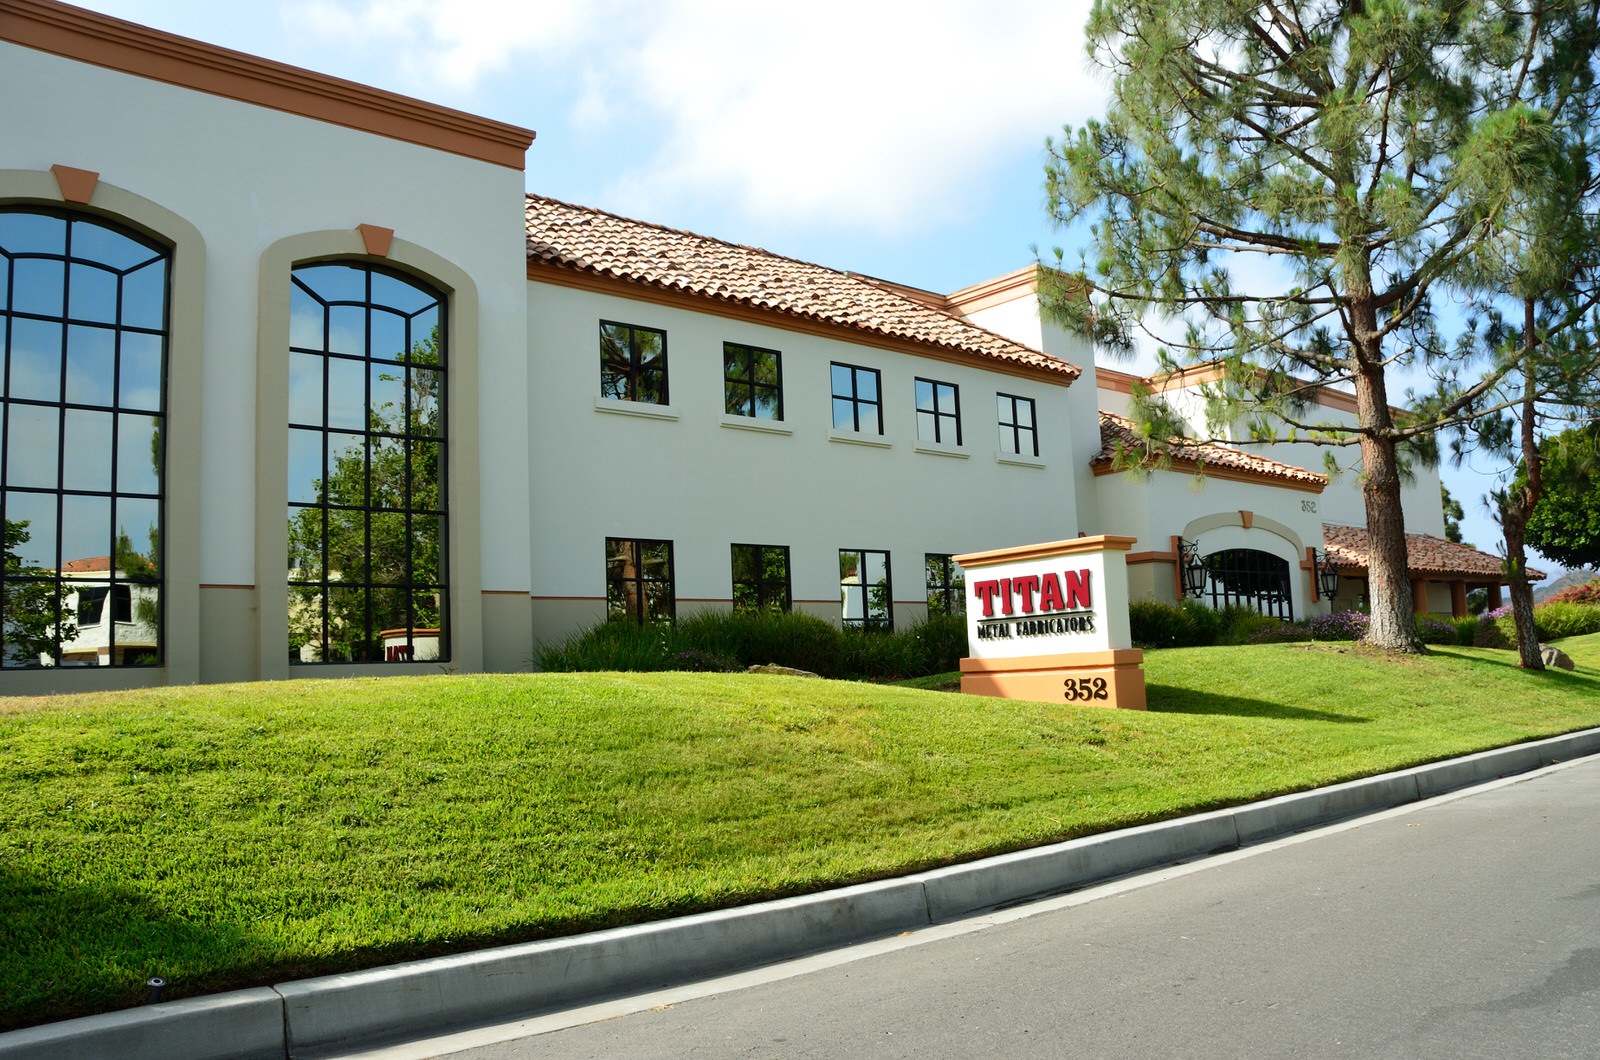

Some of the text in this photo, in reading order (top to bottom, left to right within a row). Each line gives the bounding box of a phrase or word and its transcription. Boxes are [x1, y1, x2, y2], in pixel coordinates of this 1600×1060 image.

[1301, 500, 1317, 513] 352
[974, 569, 1091, 616] TITAN
[977, 616, 1094, 639] METAL FABRICATORS
[1064, 677, 1108, 701] 352
